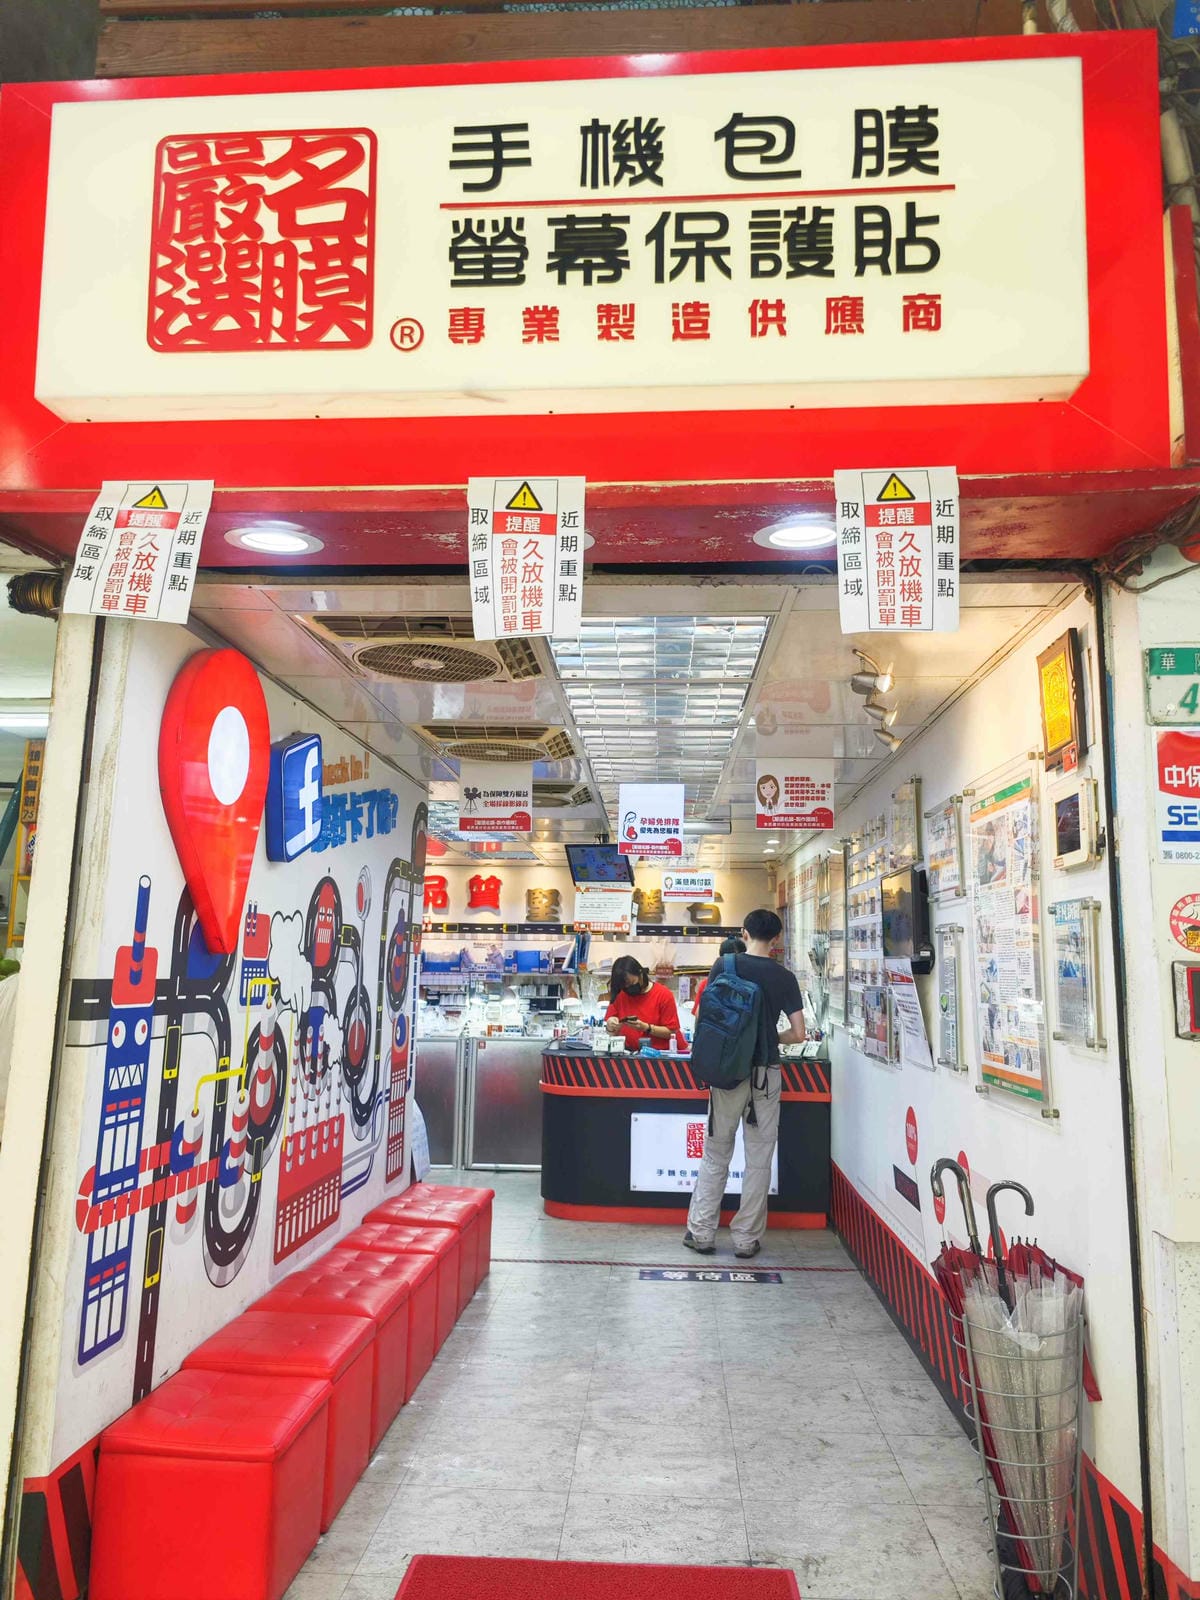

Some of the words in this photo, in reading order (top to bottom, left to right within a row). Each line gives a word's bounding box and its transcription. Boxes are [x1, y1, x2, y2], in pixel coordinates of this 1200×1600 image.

[449, 105, 939, 192] 手機包膜
[448, 201, 941, 288] 螢幕保護貼
[448, 294, 941, 344] 專業製造供應商
[74, 507, 114, 581] 取締區域
[168, 511, 203, 592] 近期重點
[471, 508, 490, 604] 取締區域
[505, 516, 541, 532] 提醒
[558, 510, 579, 602] 近期重點
[841, 501, 863, 597] 取締區域
[878, 507, 915, 525] 提醒
[936, 498, 954, 597] 近期重點
[101, 531, 136, 611] 會被開罰單
[123, 532, 159, 615] 久放機車
[500, 538, 518, 633] 會被開罰單
[521, 538, 544, 633] 久放機車
[875, 531, 896, 626] 會被開罰單
[898, 531, 923, 628] 久放機車
[640, 817, 680, 826] 孕婦免排隊
[1168, 805, 1200, 826] SE
[1175, 851, 1200, 860] 0800-2
[675, 878, 711, 886] 滿意再付款
